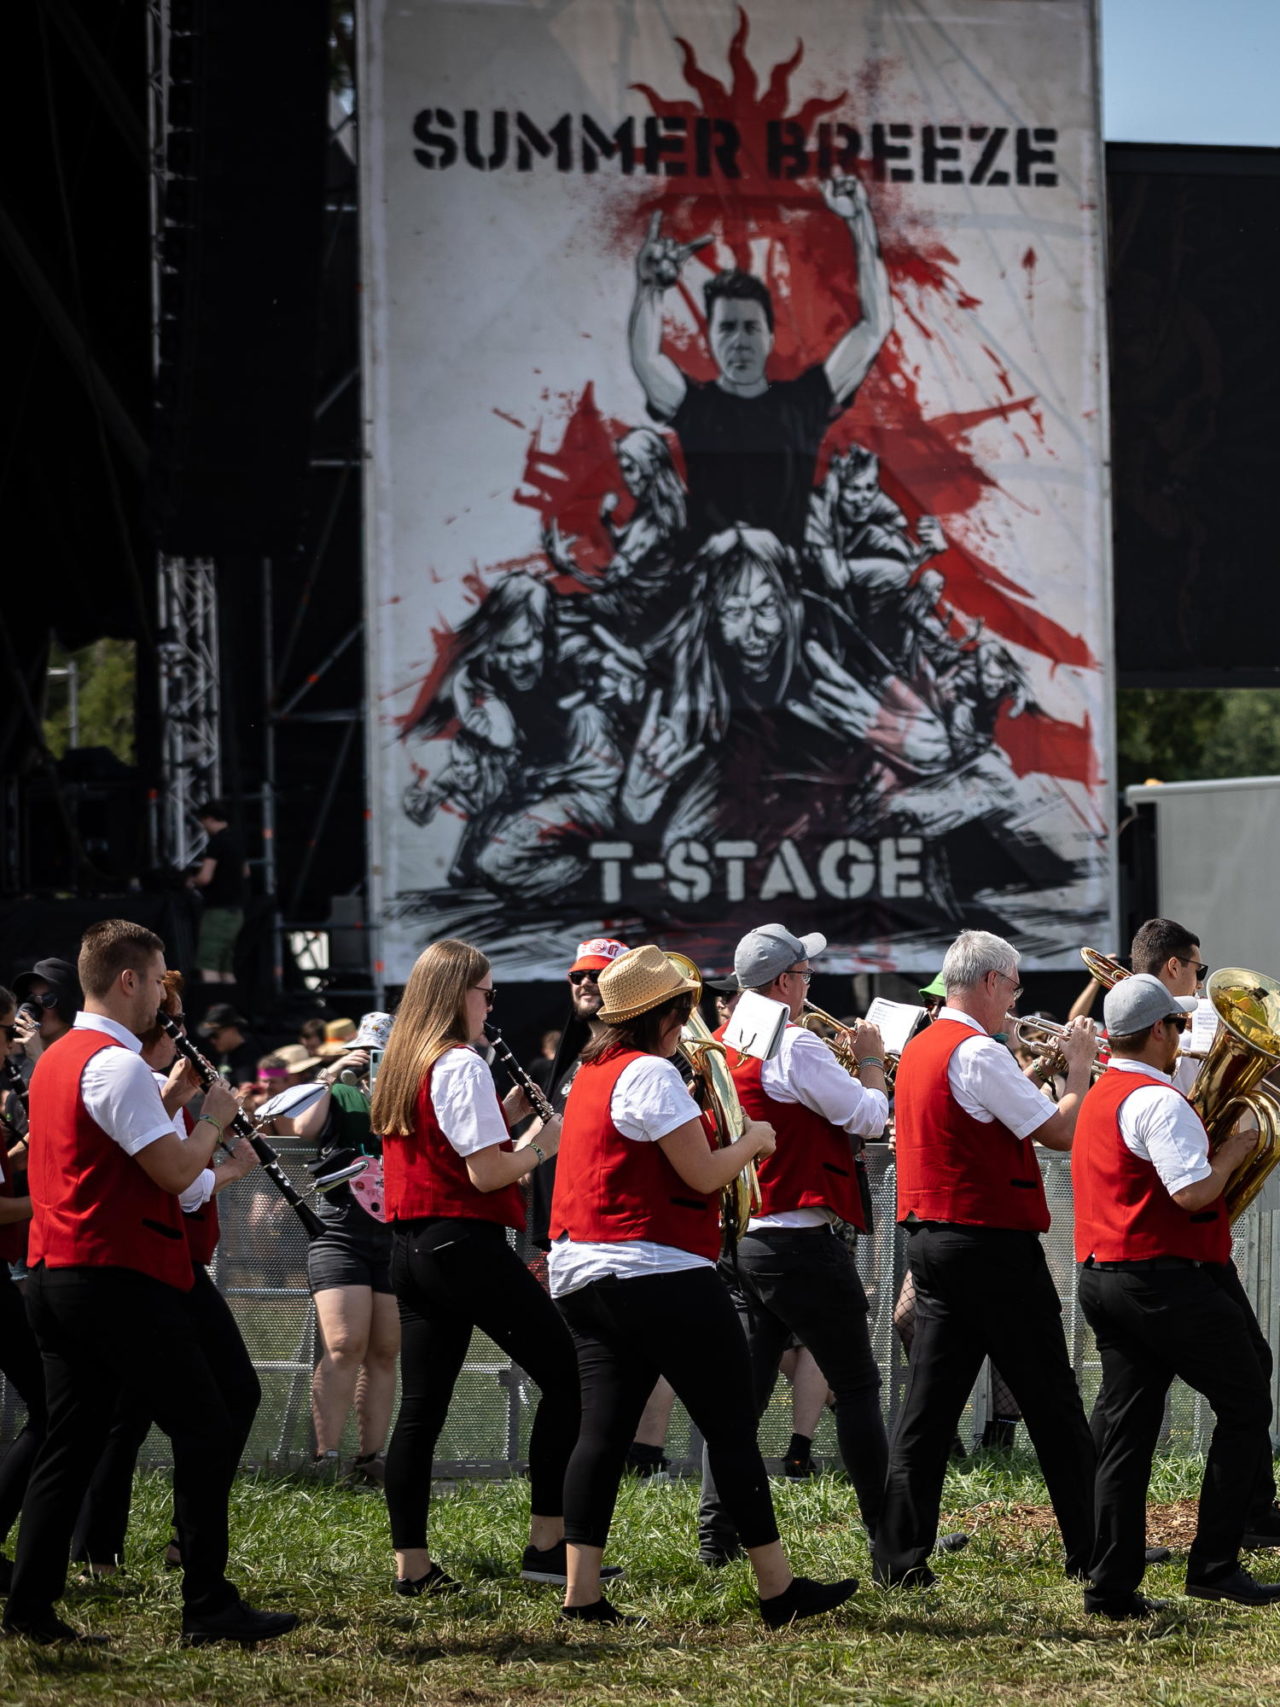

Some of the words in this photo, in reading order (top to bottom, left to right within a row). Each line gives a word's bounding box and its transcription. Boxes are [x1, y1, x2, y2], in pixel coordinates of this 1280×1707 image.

[412, 107, 741, 179] SUMMER
[766, 120, 1059, 187] BREEZE
[589, 838, 924, 902] T-STAGE
